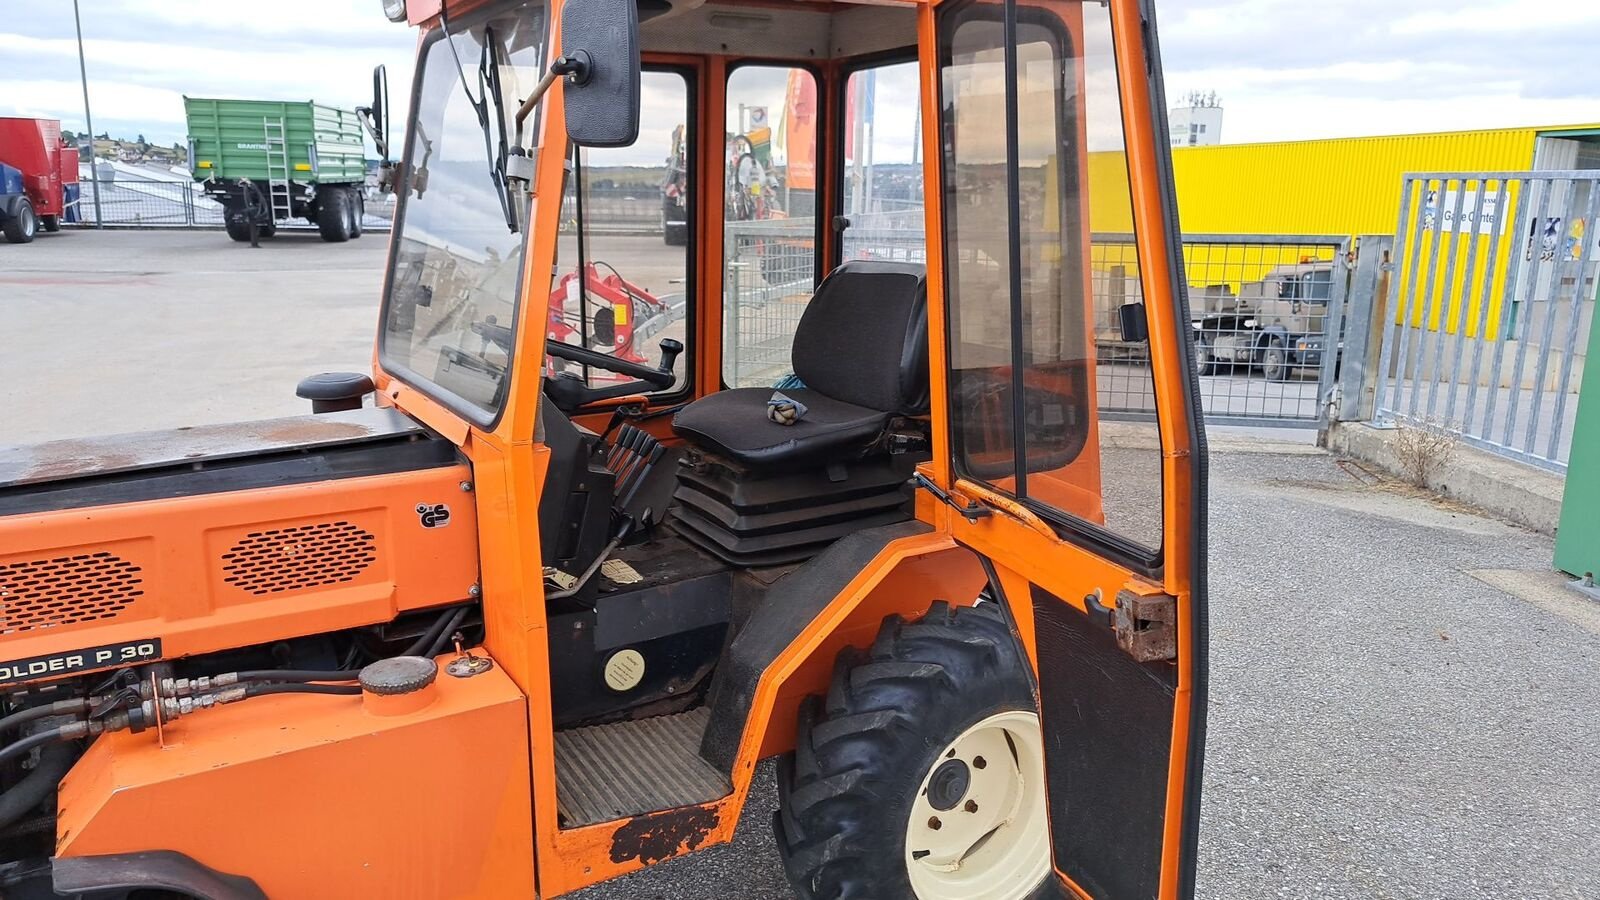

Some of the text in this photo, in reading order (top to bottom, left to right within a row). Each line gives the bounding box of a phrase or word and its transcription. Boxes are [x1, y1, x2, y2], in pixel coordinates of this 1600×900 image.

[421, 504, 450, 528] GS
[96, 650, 113, 663] P
[120, 643, 154, 662] 30
